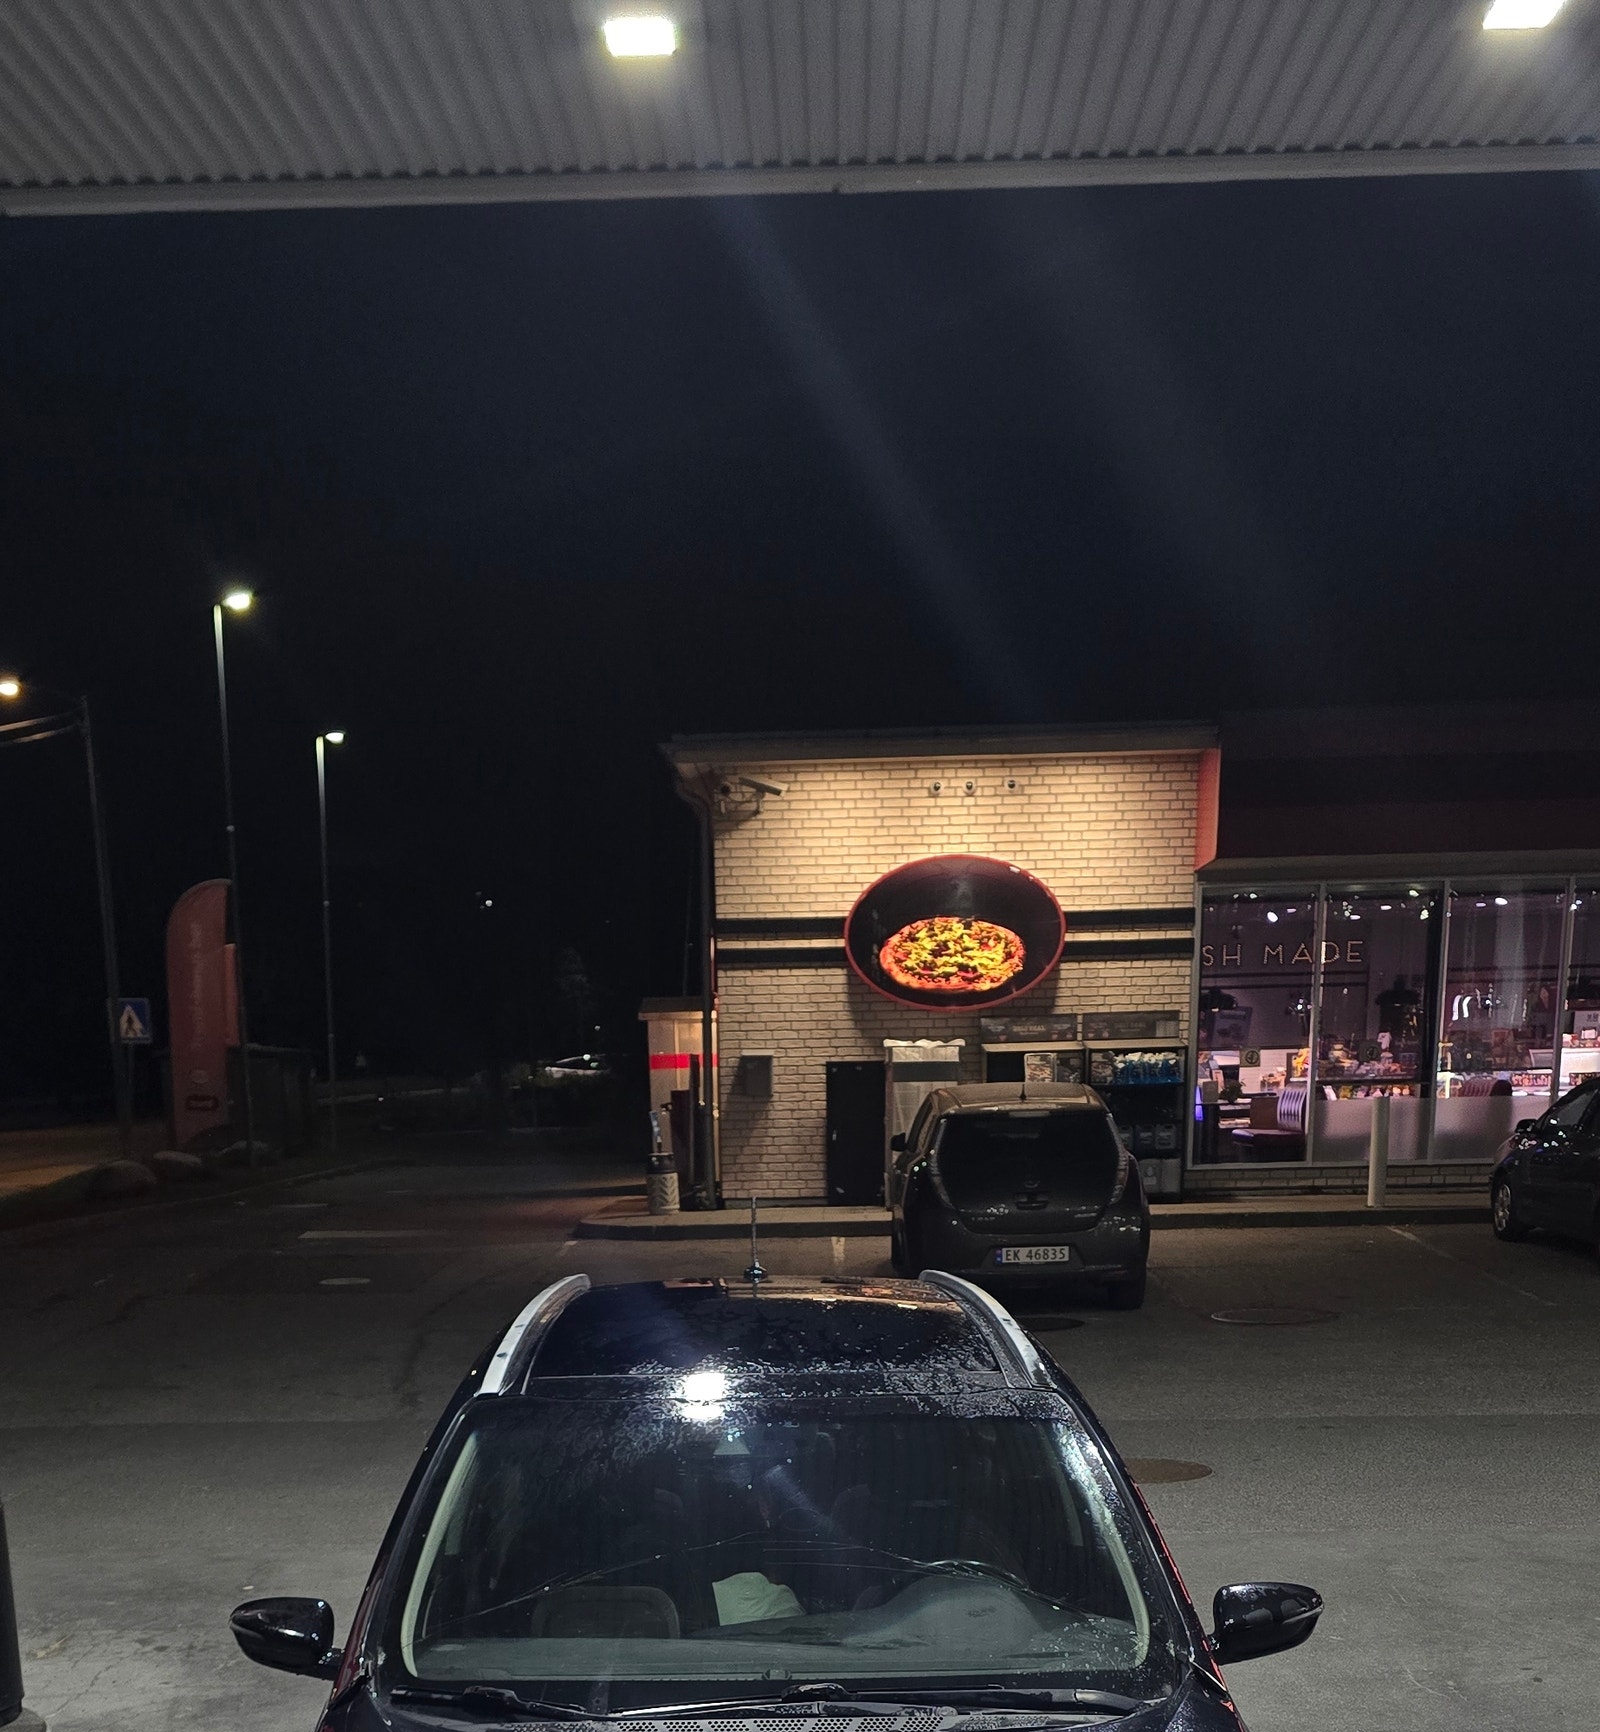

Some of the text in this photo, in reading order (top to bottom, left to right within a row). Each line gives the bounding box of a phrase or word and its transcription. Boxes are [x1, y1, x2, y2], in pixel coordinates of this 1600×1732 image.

[1263, 940, 1364, 965] MADE
[1005, 1249, 1021, 1261] EK
[1025, 1247, 1066, 1261] 46835
